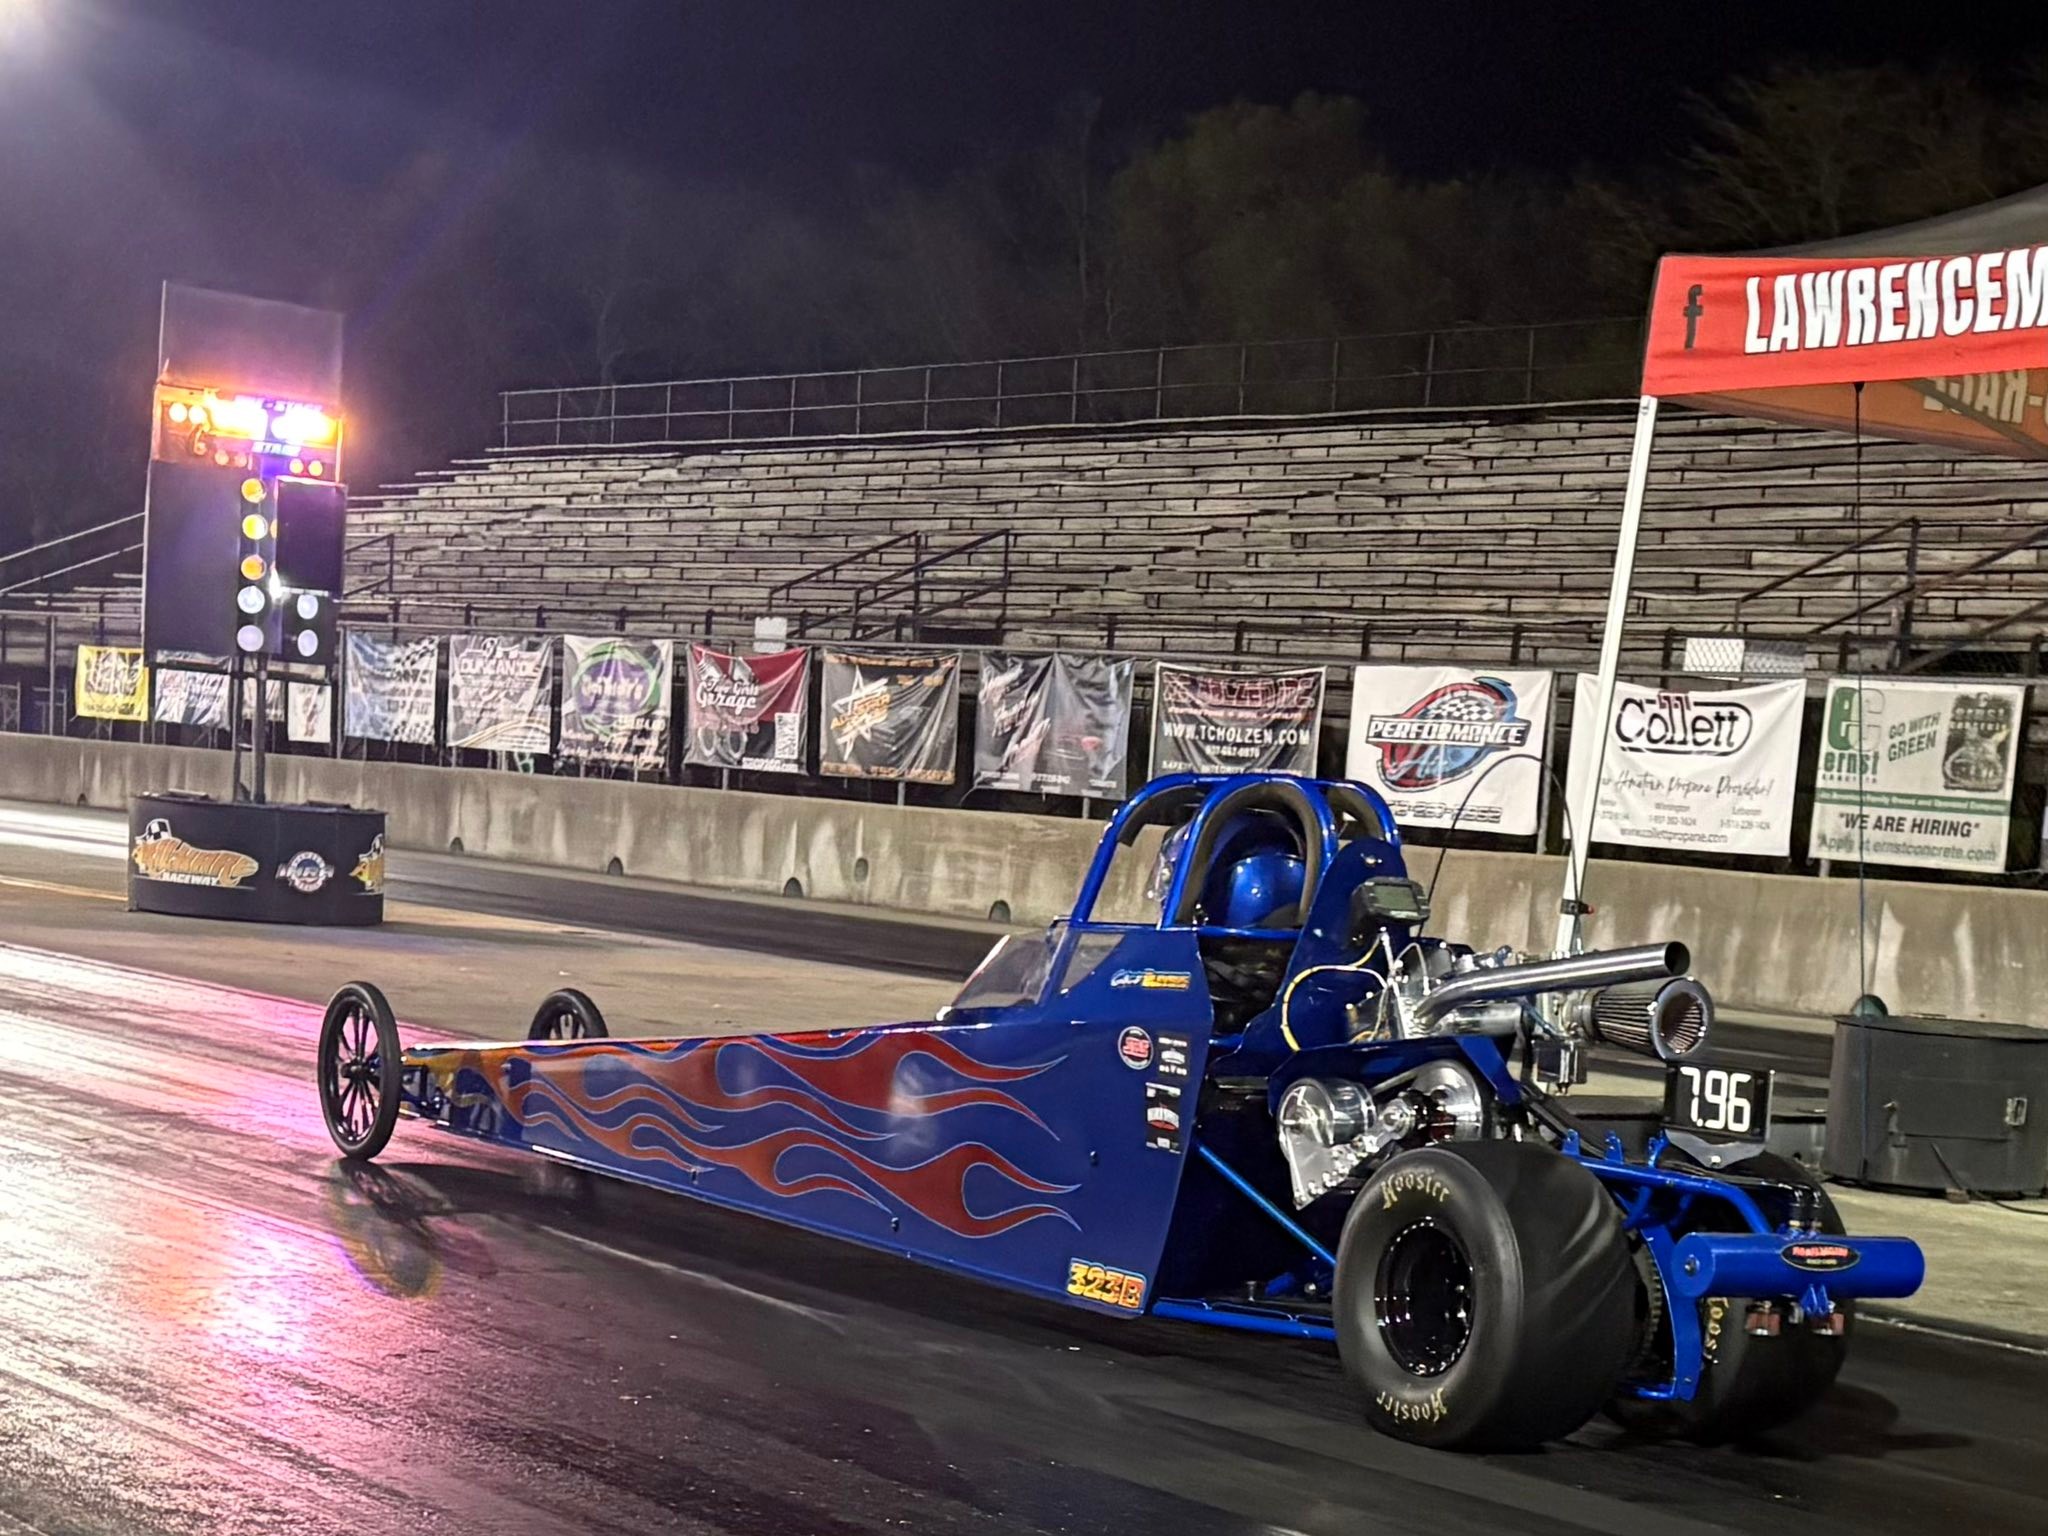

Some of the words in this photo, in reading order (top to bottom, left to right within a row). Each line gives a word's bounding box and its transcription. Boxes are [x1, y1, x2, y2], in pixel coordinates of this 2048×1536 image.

[1744, 247, 2048, 354] LAWRENCEM
[696, 682, 757, 715] Garage
[1163, 721, 1311, 746] WWW.TCHOLZEN.COM
[1369, 720, 1527, 745] PERFORMANCE
[1615, 694, 1739, 747] Collett
[1889, 723, 1905, 740] GO
[1909, 712, 1941, 735] WITH
[1888, 731, 1937, 762] GREEN
[1824, 751, 1880, 775] ernst
[1873, 815, 1906, 833] ARE
[1873, 839, 1997, 862] ernstconcrete.com
[162, 871, 219, 887] RACEWAY
[1680, 1066, 1752, 1133] 7.96
[1381, 1173, 1450, 1210] Hoosier
[1376, 1387, 1448, 1423] Hoosier
